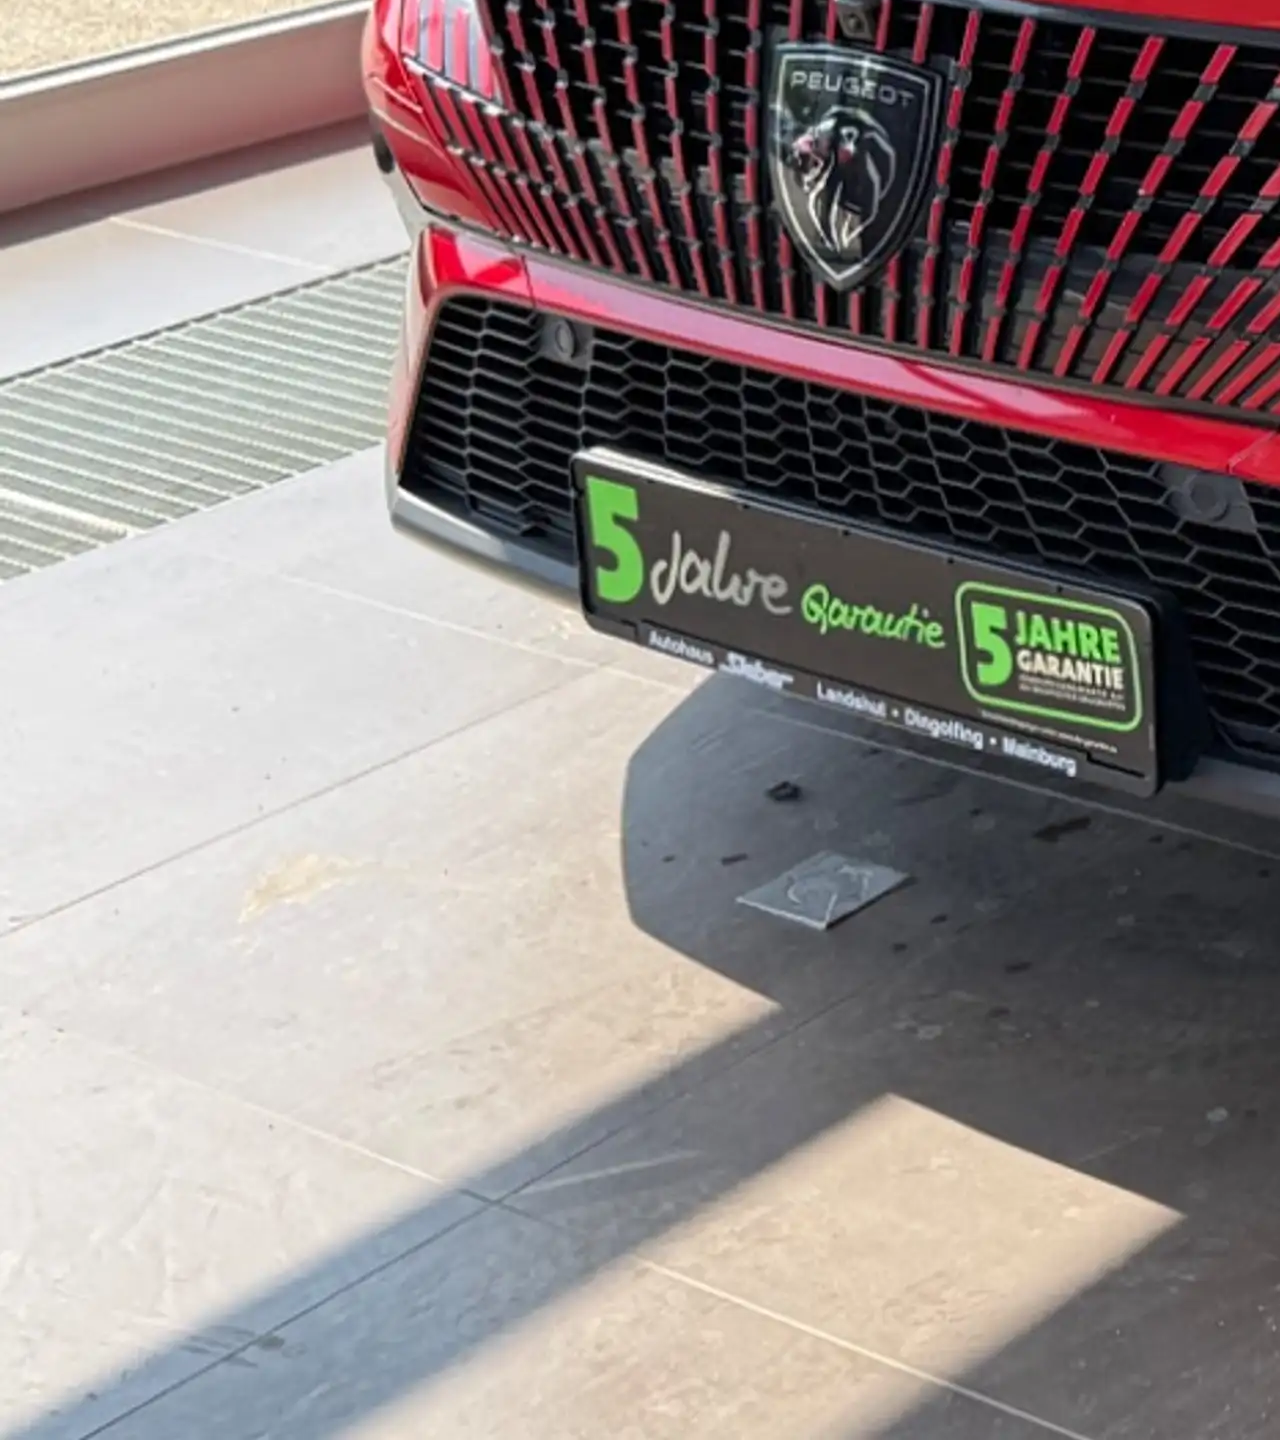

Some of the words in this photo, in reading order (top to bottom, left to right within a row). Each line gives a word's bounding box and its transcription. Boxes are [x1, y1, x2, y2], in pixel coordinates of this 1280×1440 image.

[790, 70, 915, 107] PEUGEOT
[586, 475, 643, 602] 5
[651, 530, 793, 615] Jahre
[971, 601, 1013, 685] 5
[1015, 610, 1121, 664] JAHRE
[1017, 649, 1125, 690] GARANTIE
[649, 630, 714, 665] Autohaus
[816, 680, 887, 718] Landshut
[904, 707, 984, 751] Dingolfing
